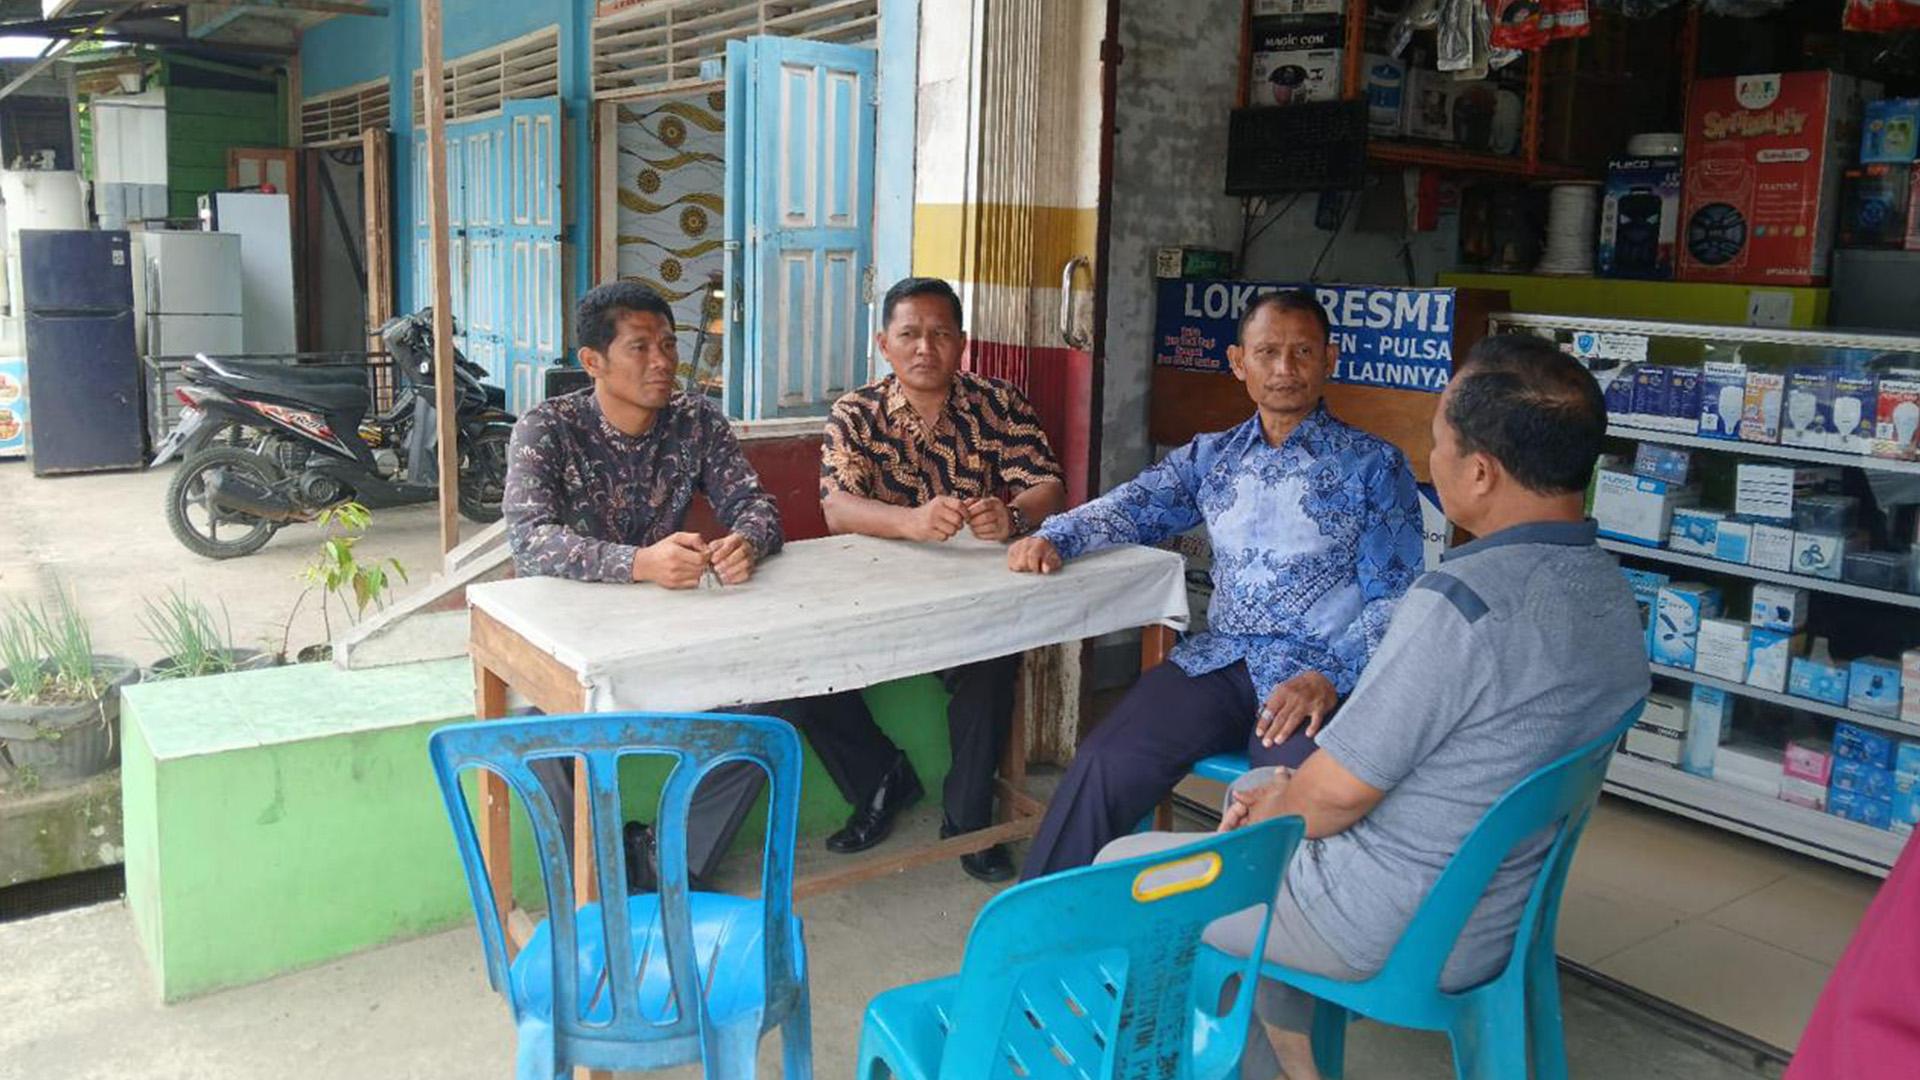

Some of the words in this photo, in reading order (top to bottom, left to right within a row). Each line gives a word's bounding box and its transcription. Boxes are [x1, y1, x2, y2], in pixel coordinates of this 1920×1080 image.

[1185, 283, 1299, 319] LOK
[1315, 288, 1451, 332] RESMI
[1379, 335, 1452, 361] PULSA
[1348, 361, 1449, 388] LAINNYA
